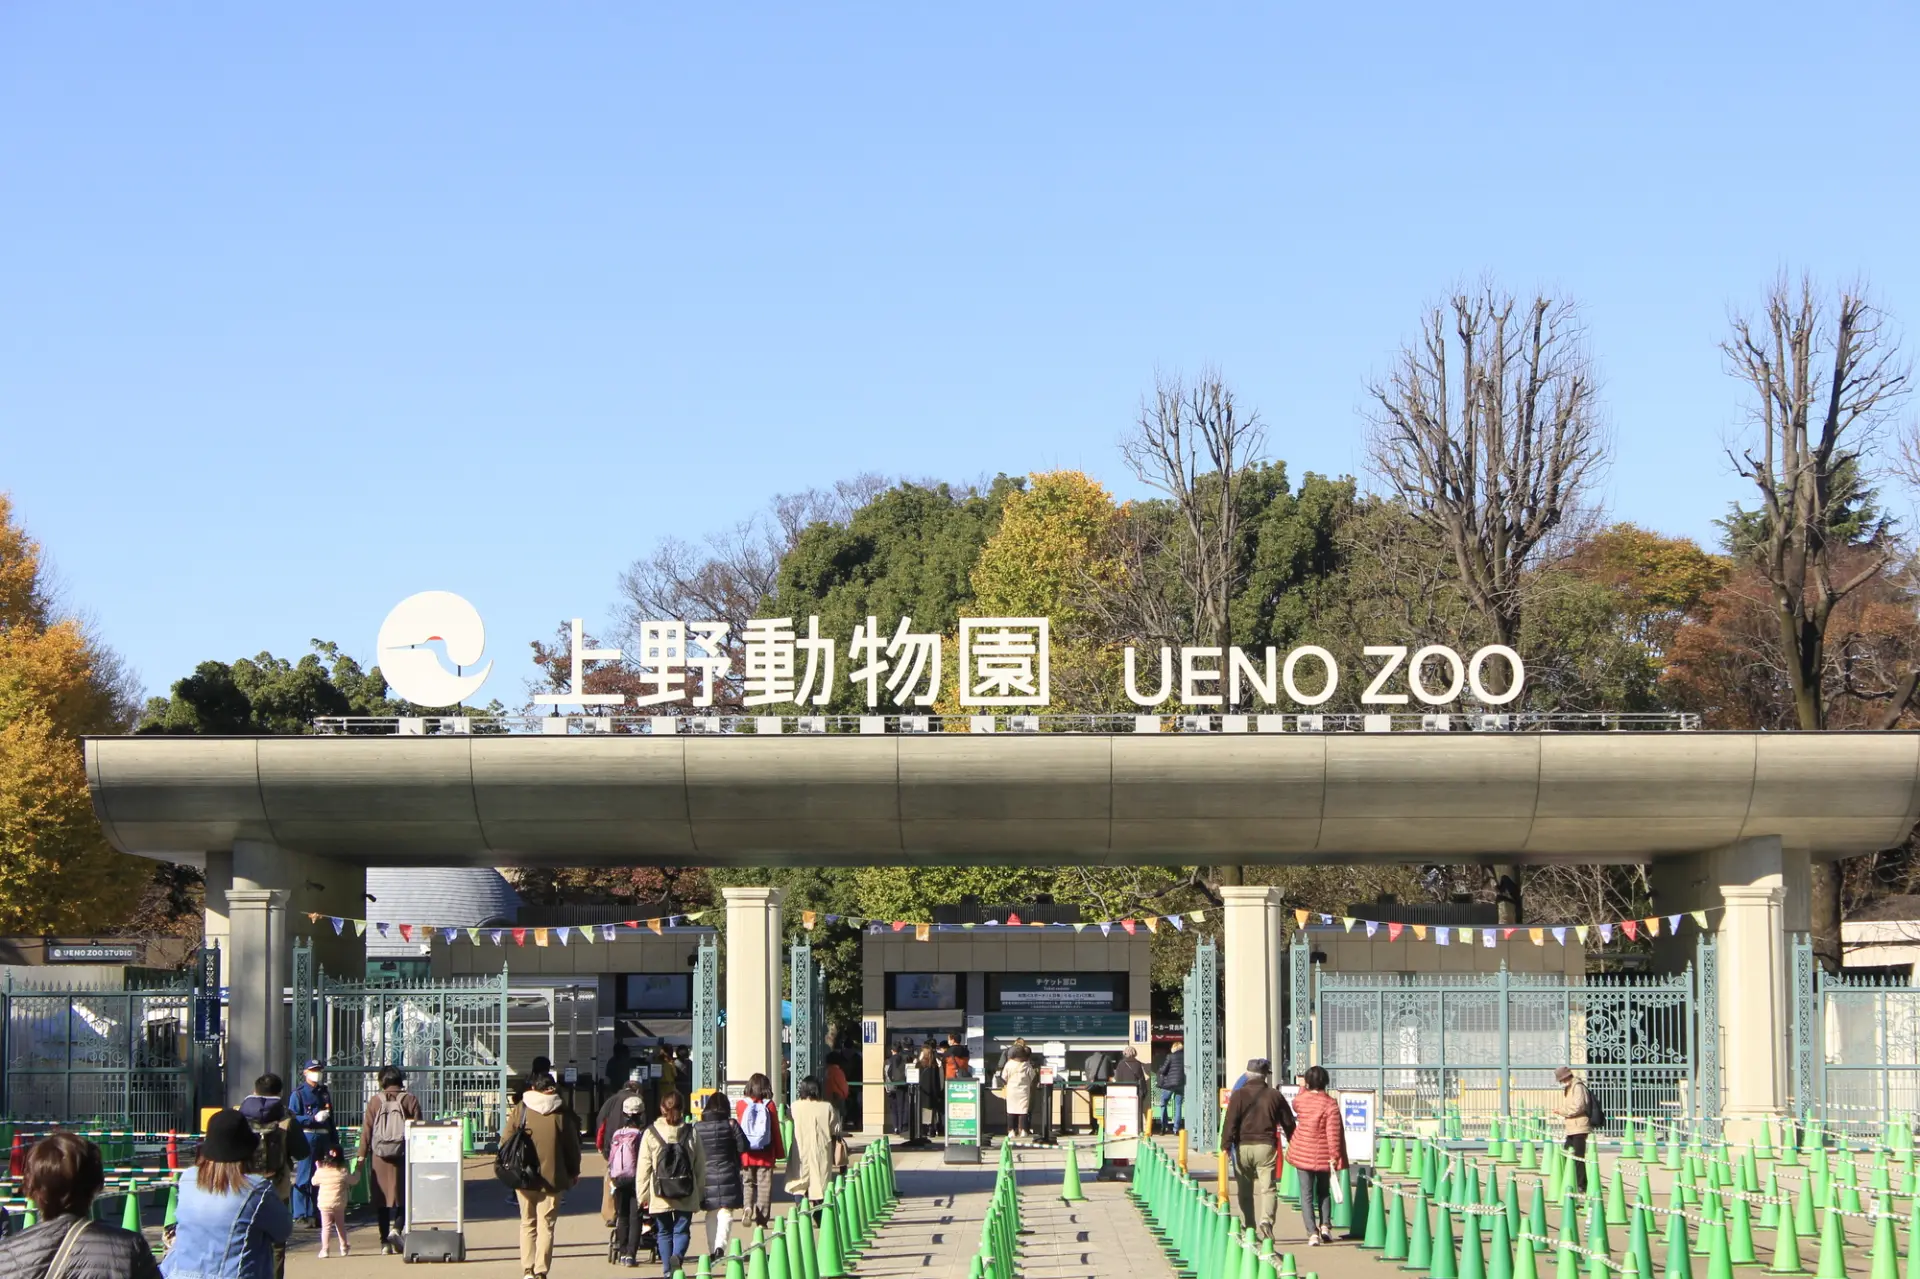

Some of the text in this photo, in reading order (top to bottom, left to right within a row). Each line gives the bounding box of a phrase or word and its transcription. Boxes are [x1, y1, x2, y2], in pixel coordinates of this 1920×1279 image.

[534, 615, 1050, 707] 上野動物園
[1124, 644, 1525, 705] UENO ZOO
[63, 949, 133, 957] UENO ZOO STUDIO
